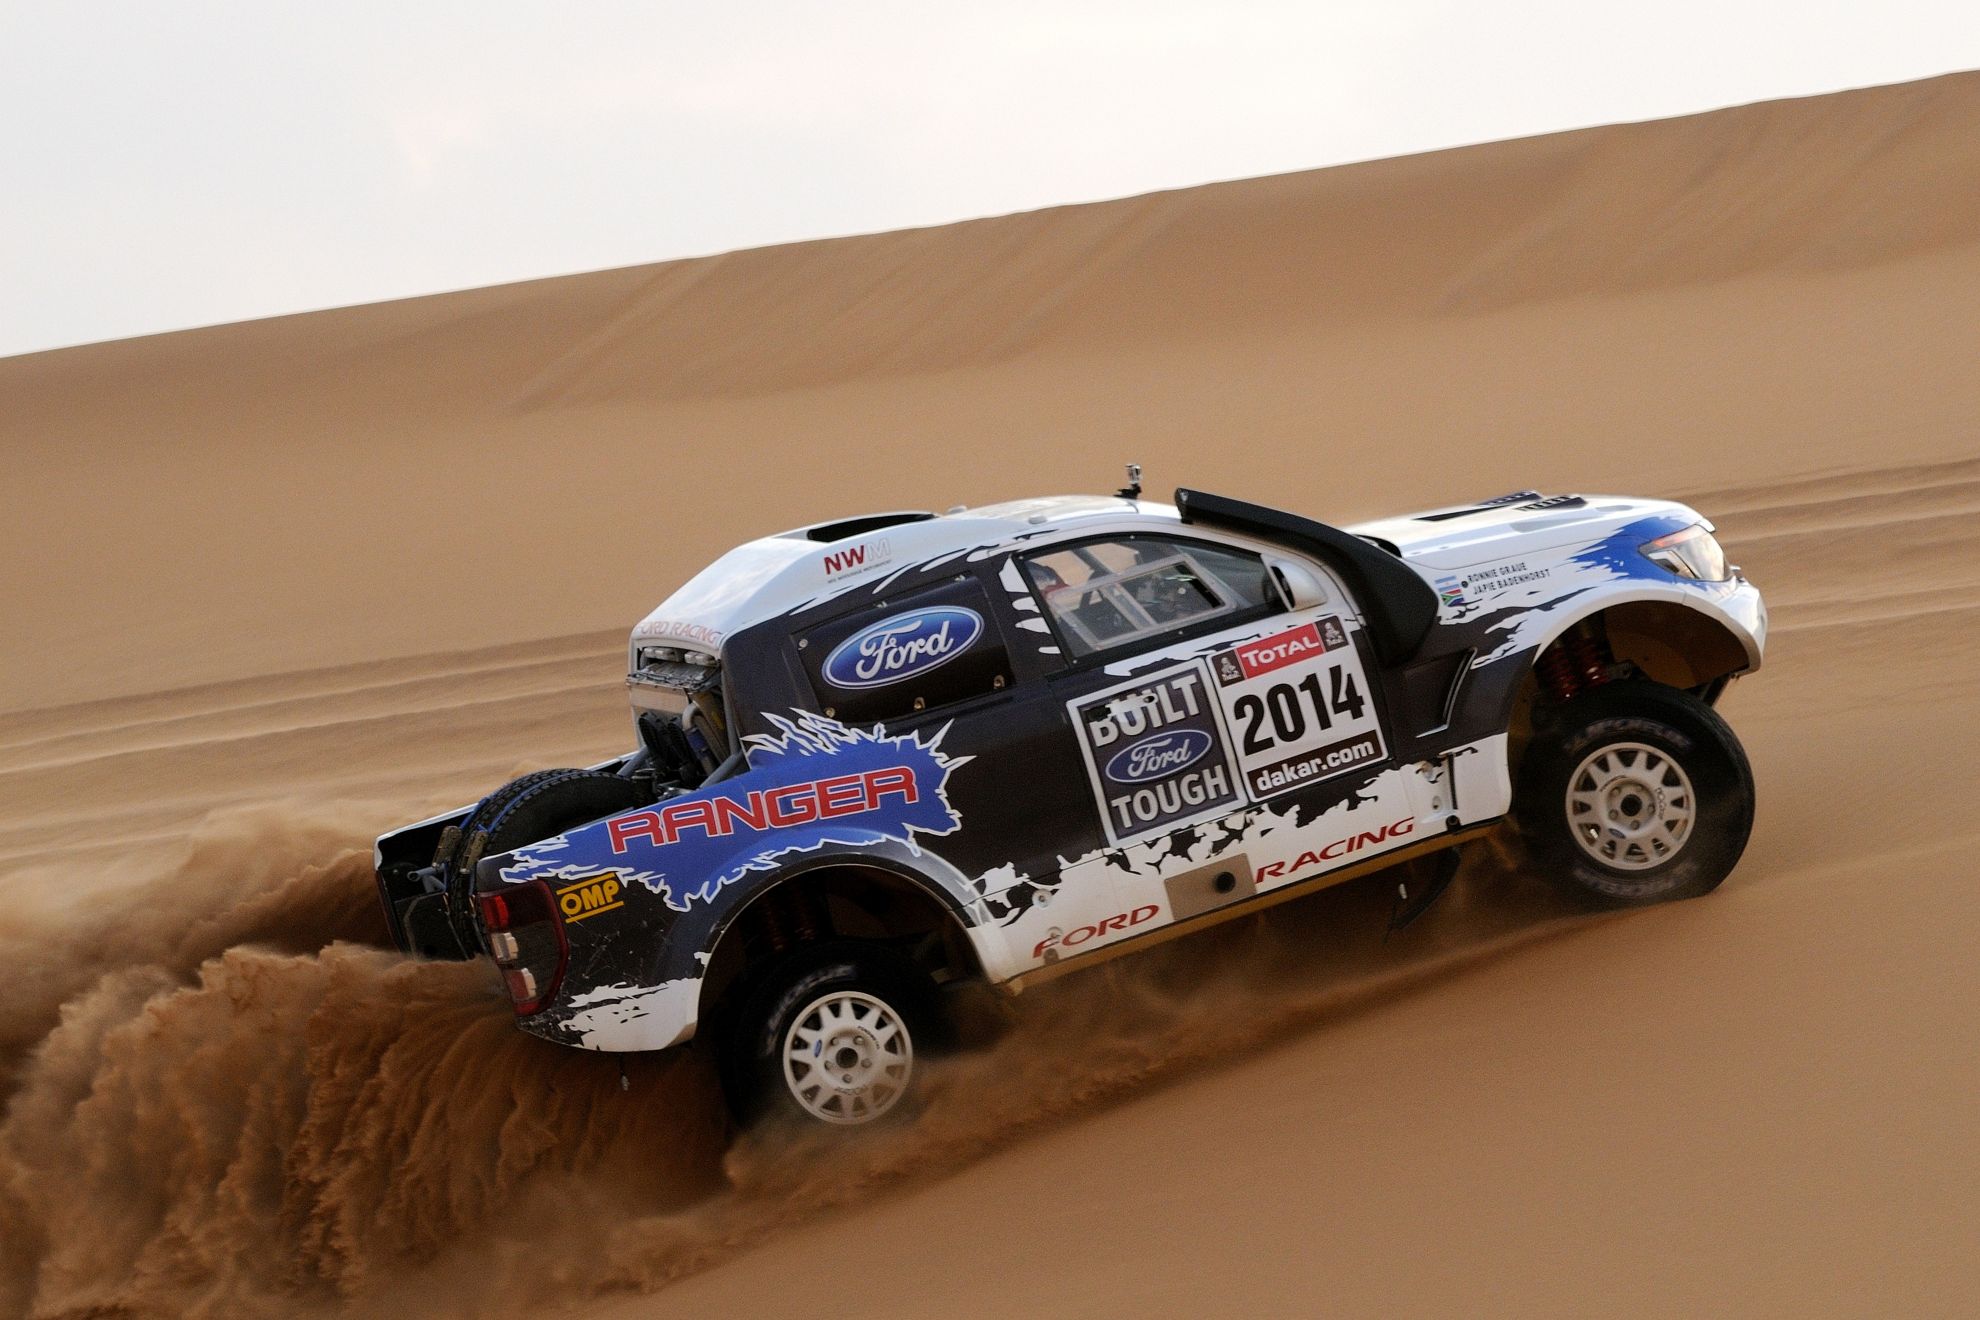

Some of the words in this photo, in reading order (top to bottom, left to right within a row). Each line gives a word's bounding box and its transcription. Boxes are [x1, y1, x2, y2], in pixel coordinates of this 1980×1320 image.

[824, 537, 892, 576] NWM
[670, 622, 722, 645] RACING
[855, 619, 954, 680] Ford
[1242, 636, 1320, 668] TOTAL
[1089, 675, 1200, 748] BUILT
[1233, 664, 1366, 757] 2014
[1127, 737, 1192, 778] Ford
[1256, 738, 1375, 792] dakar.com
[606, 766, 919, 855] RANGER
[1111, 765, 1230, 829] TOUGH
[560, 879, 619, 916] OMP
[1032, 904, 1160, 959] FORD
[1255, 816, 1414, 884] RACING
